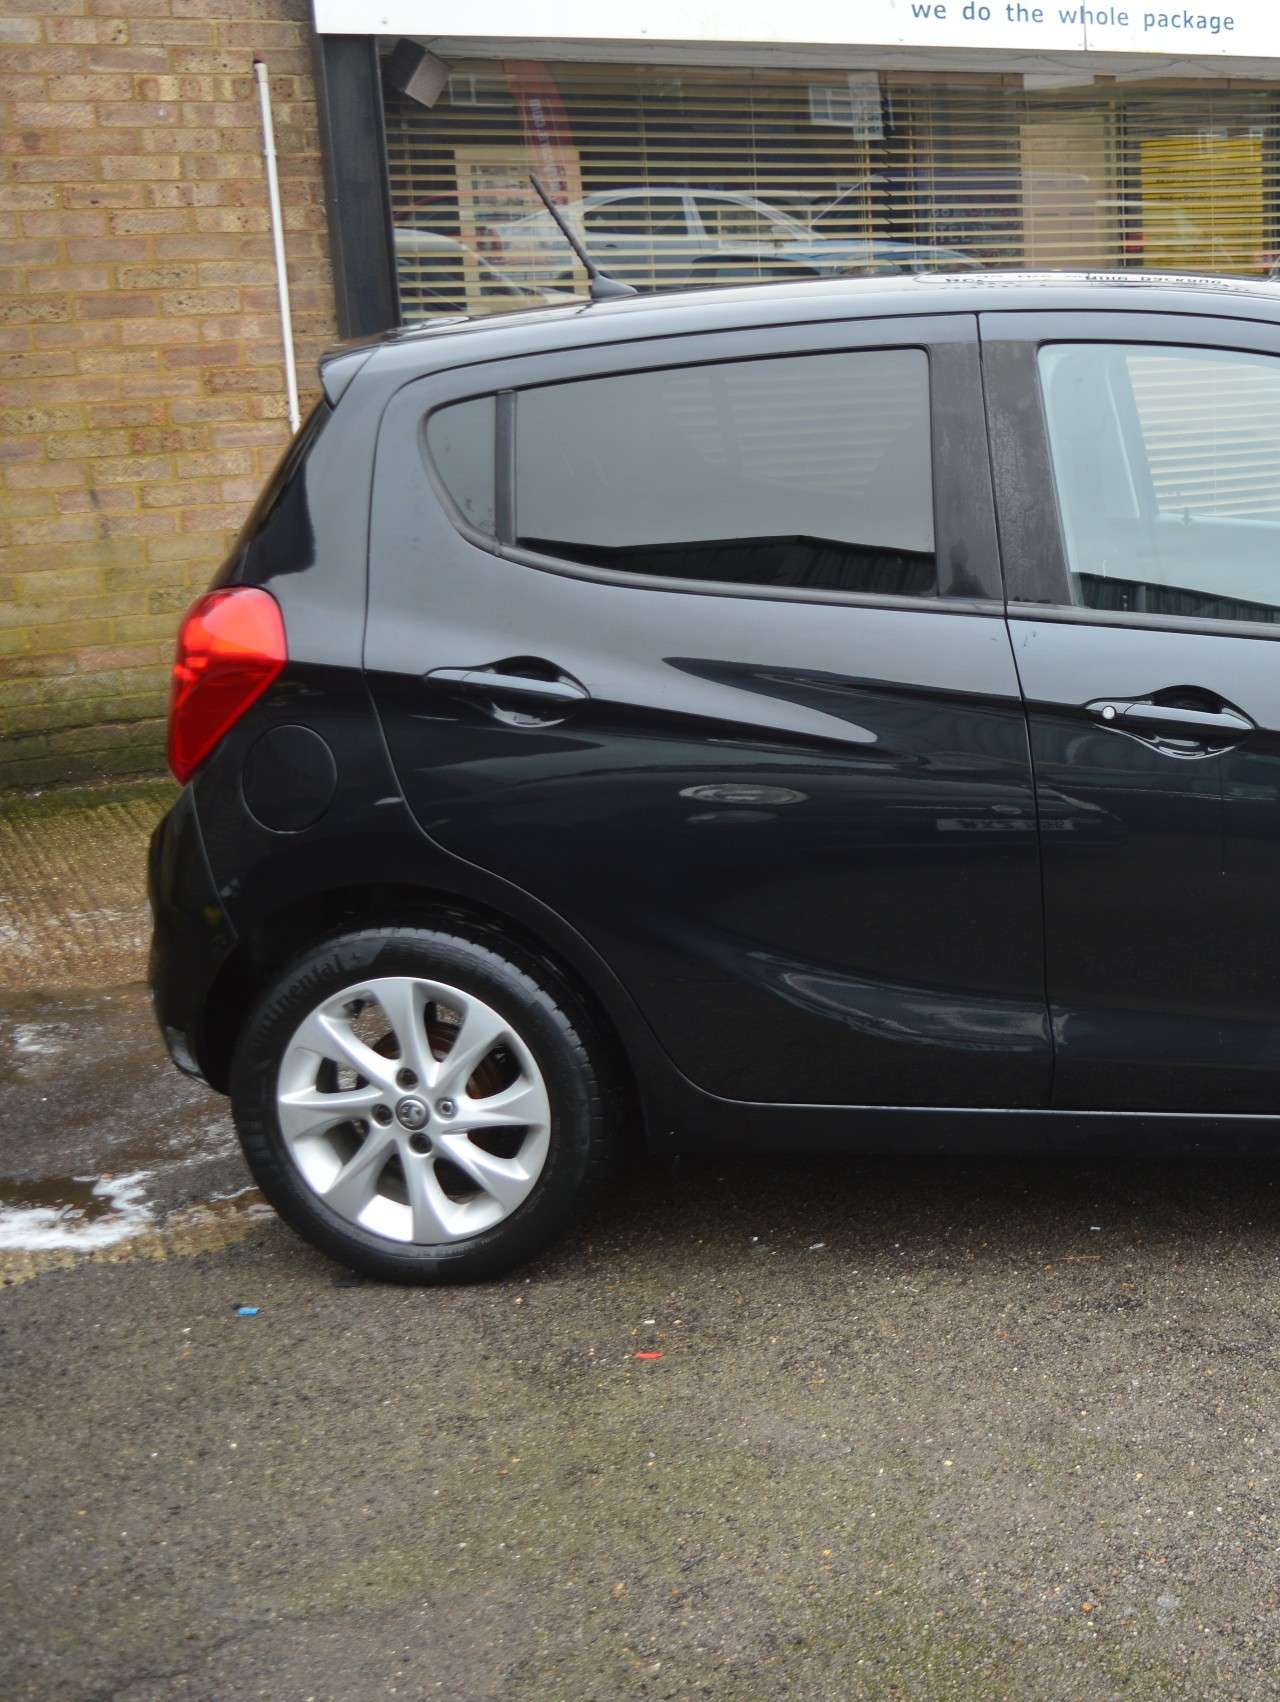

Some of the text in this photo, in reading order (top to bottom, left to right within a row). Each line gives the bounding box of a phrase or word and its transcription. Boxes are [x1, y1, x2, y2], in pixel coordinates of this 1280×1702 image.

[911, 1, 1235, 34] we do the whole package
